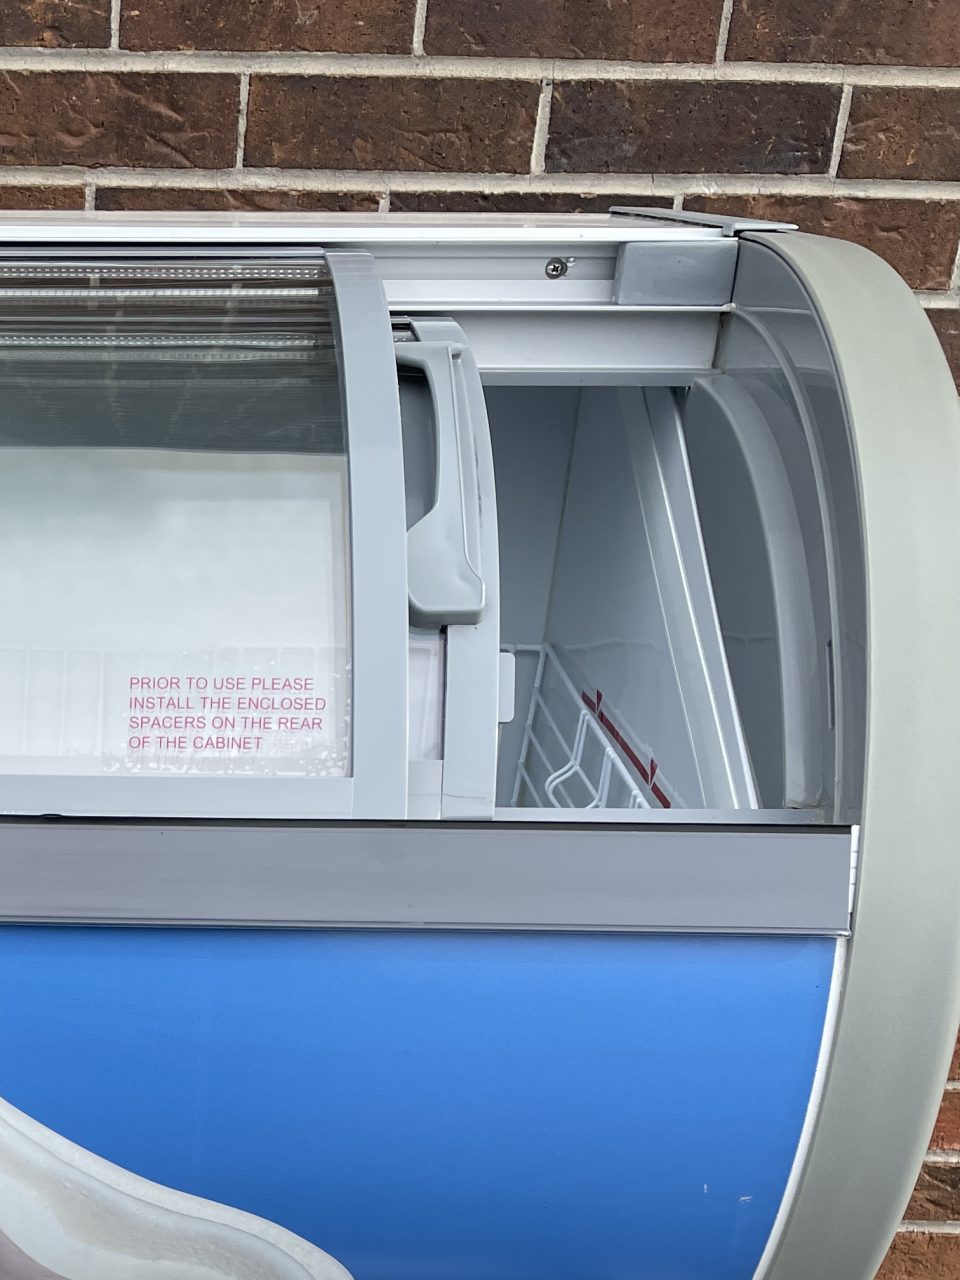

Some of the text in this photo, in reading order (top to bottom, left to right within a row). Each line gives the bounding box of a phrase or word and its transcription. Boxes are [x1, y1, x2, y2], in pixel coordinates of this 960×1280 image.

[130, 677, 314, 691] PRIOR TO USE PLEASE
[129, 696, 326, 711] INSTALL THE ENCLOSED
[129, 716, 322, 730] SPACERS ON THE REAR
[129, 736, 263, 750] OF THE CABINET
